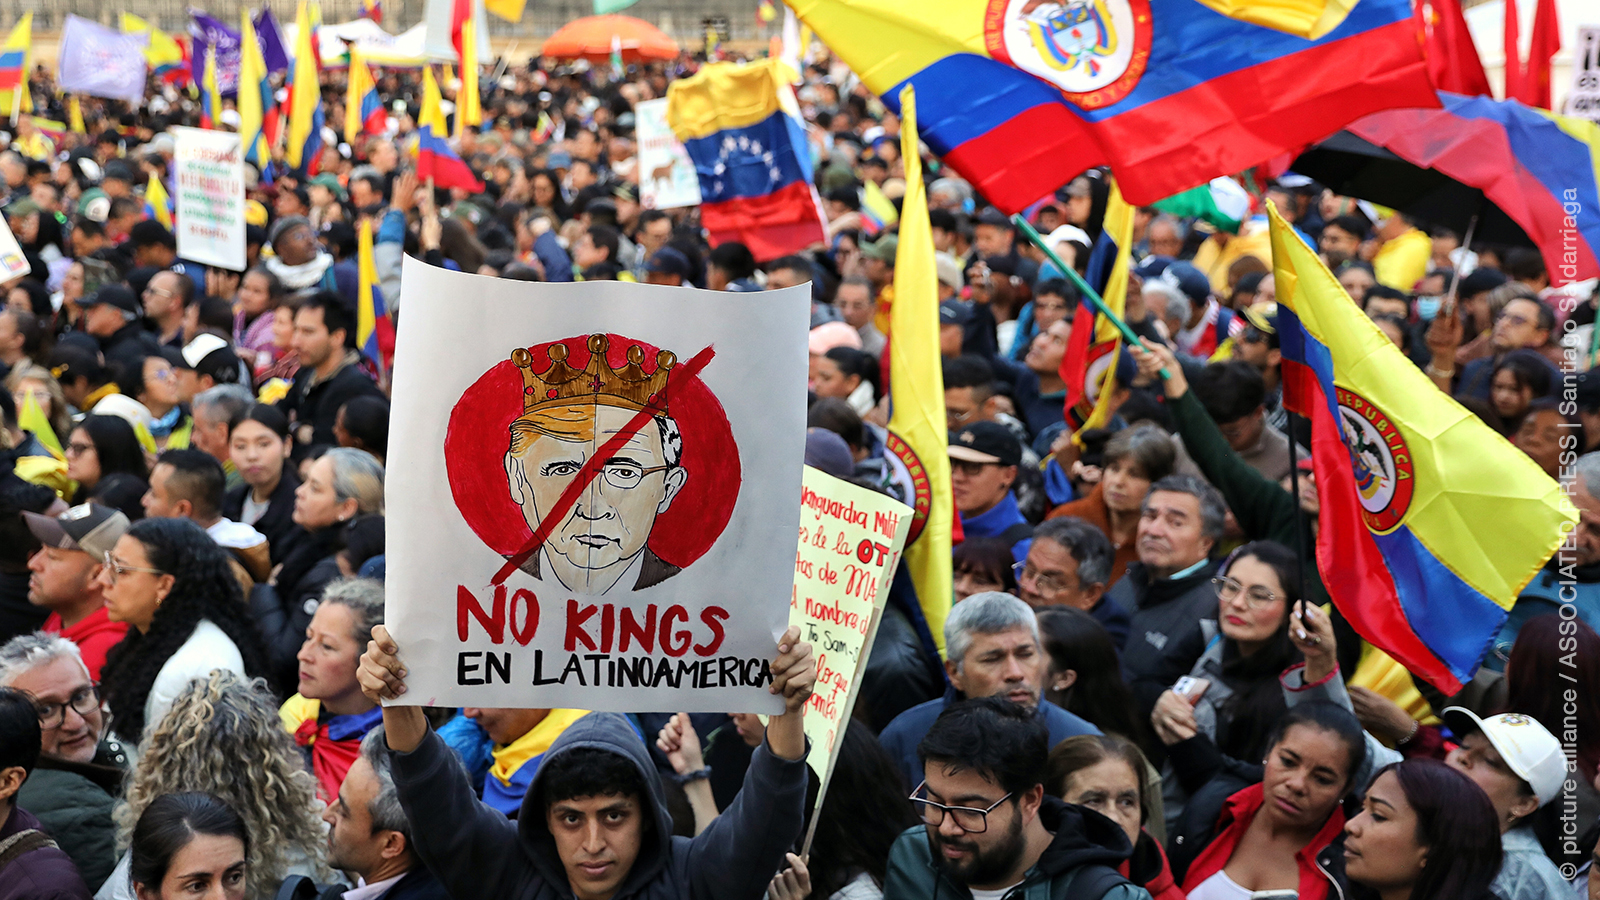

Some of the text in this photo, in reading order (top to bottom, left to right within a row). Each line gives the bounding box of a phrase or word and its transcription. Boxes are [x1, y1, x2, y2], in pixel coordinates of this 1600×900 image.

[812, 525, 827, 549] de
[832, 531, 853, 556] la
[818, 561, 838, 585] de
[457, 584, 730, 657] NO KINGS
[805, 596, 859, 629] nombre
[457, 649, 773, 689] EN LATINOAMERICA
